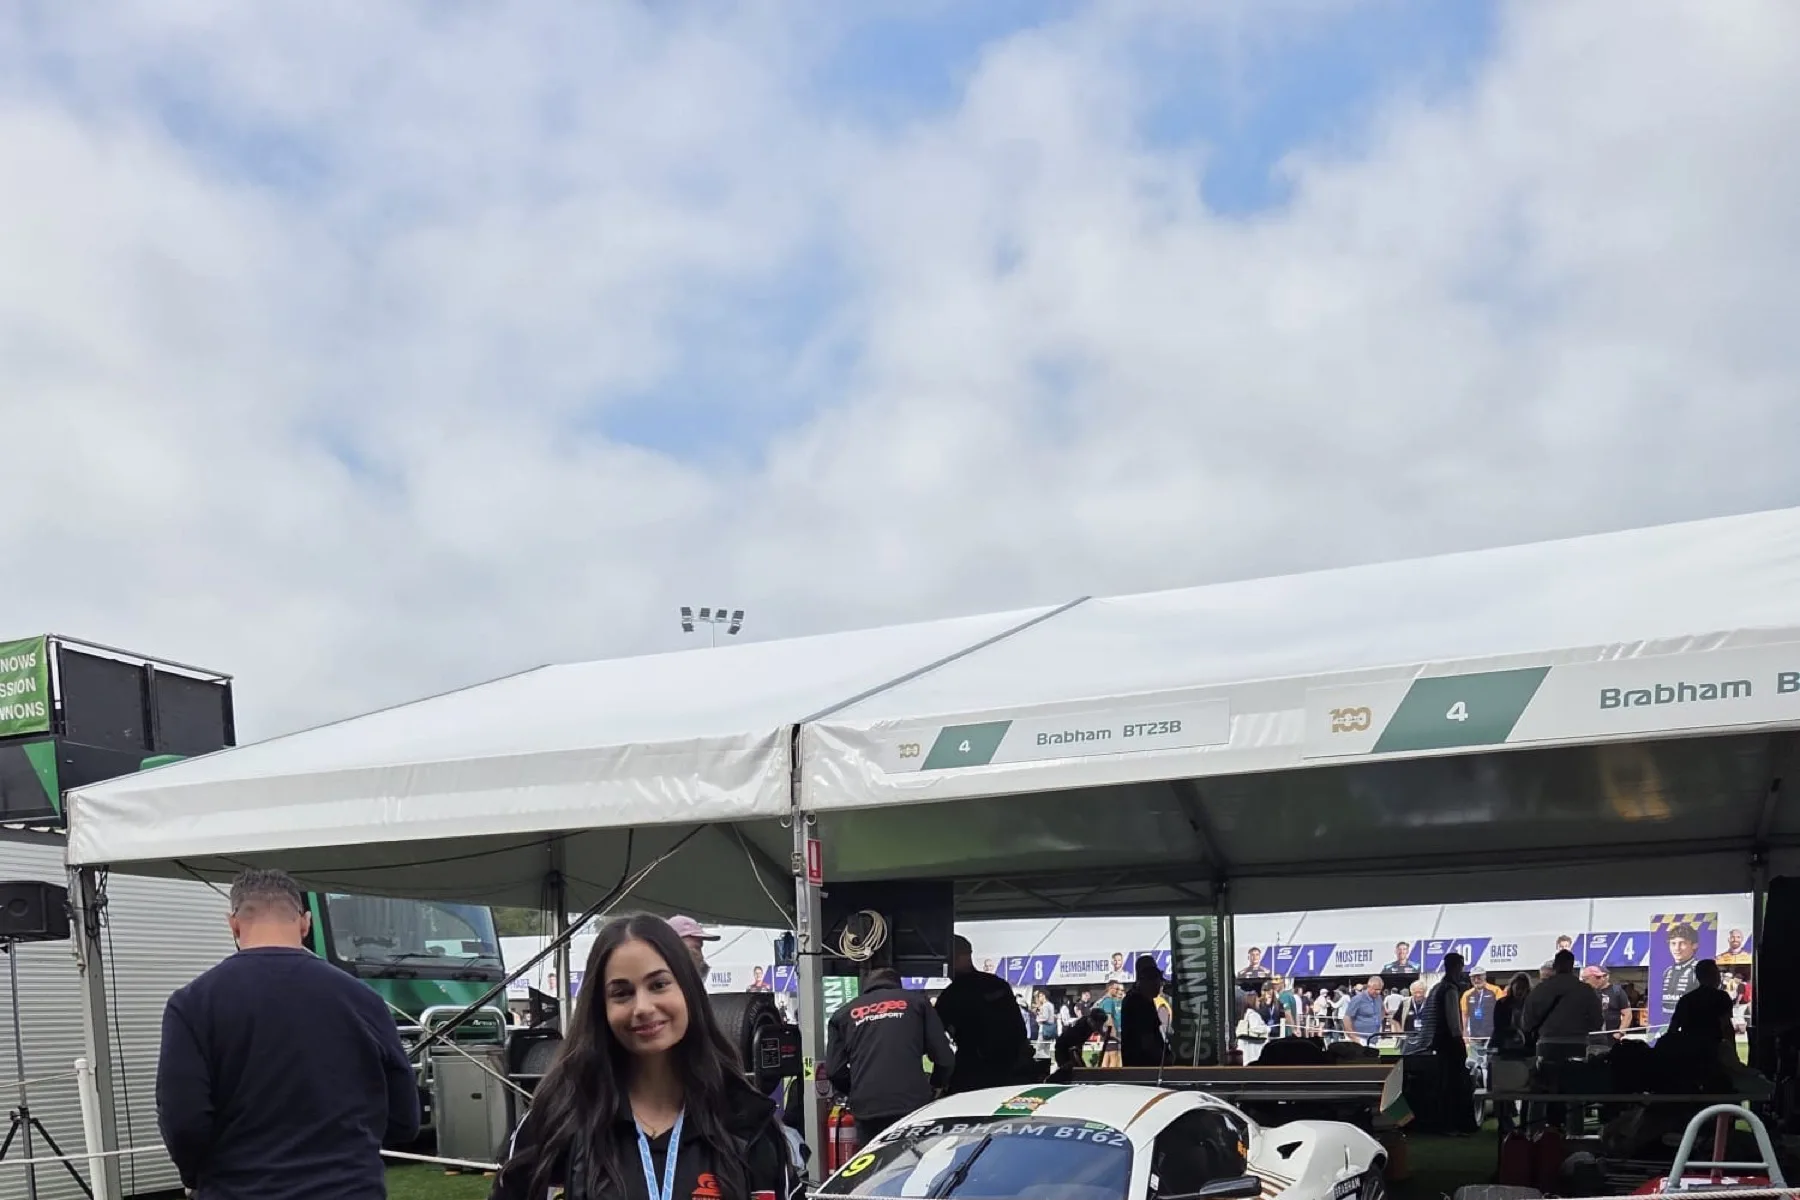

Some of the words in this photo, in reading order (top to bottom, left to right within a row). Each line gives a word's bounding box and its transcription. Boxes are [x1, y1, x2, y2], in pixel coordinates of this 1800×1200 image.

[1446, 701, 1468, 722] 4
[1600, 680, 1752, 710] Brabham
[1328, 706, 1373, 733] 100
[959, 740, 970, 753] 4
[1036, 729, 1111, 746] Brabham
[1123, 720, 1182, 738] BT23B
[1307, 949, 1314, 971] 1
[1335, 949, 1373, 963] MOSTERT
[1490, 943, 1518, 958] BATES
[1623, 937, 1635, 960] 4
[1034, 960, 1044, 980] 8
[1060, 959, 1110, 973] HEIMGARTNER
[1176, 915, 1211, 1060] SHANNO
[850, 1000, 908, 1019] apogee
[886, 1122, 1047, 1141] BRABHAM
[1054, 1125, 1127, 1147] BT62
[841, 1153, 875, 1178] 9
